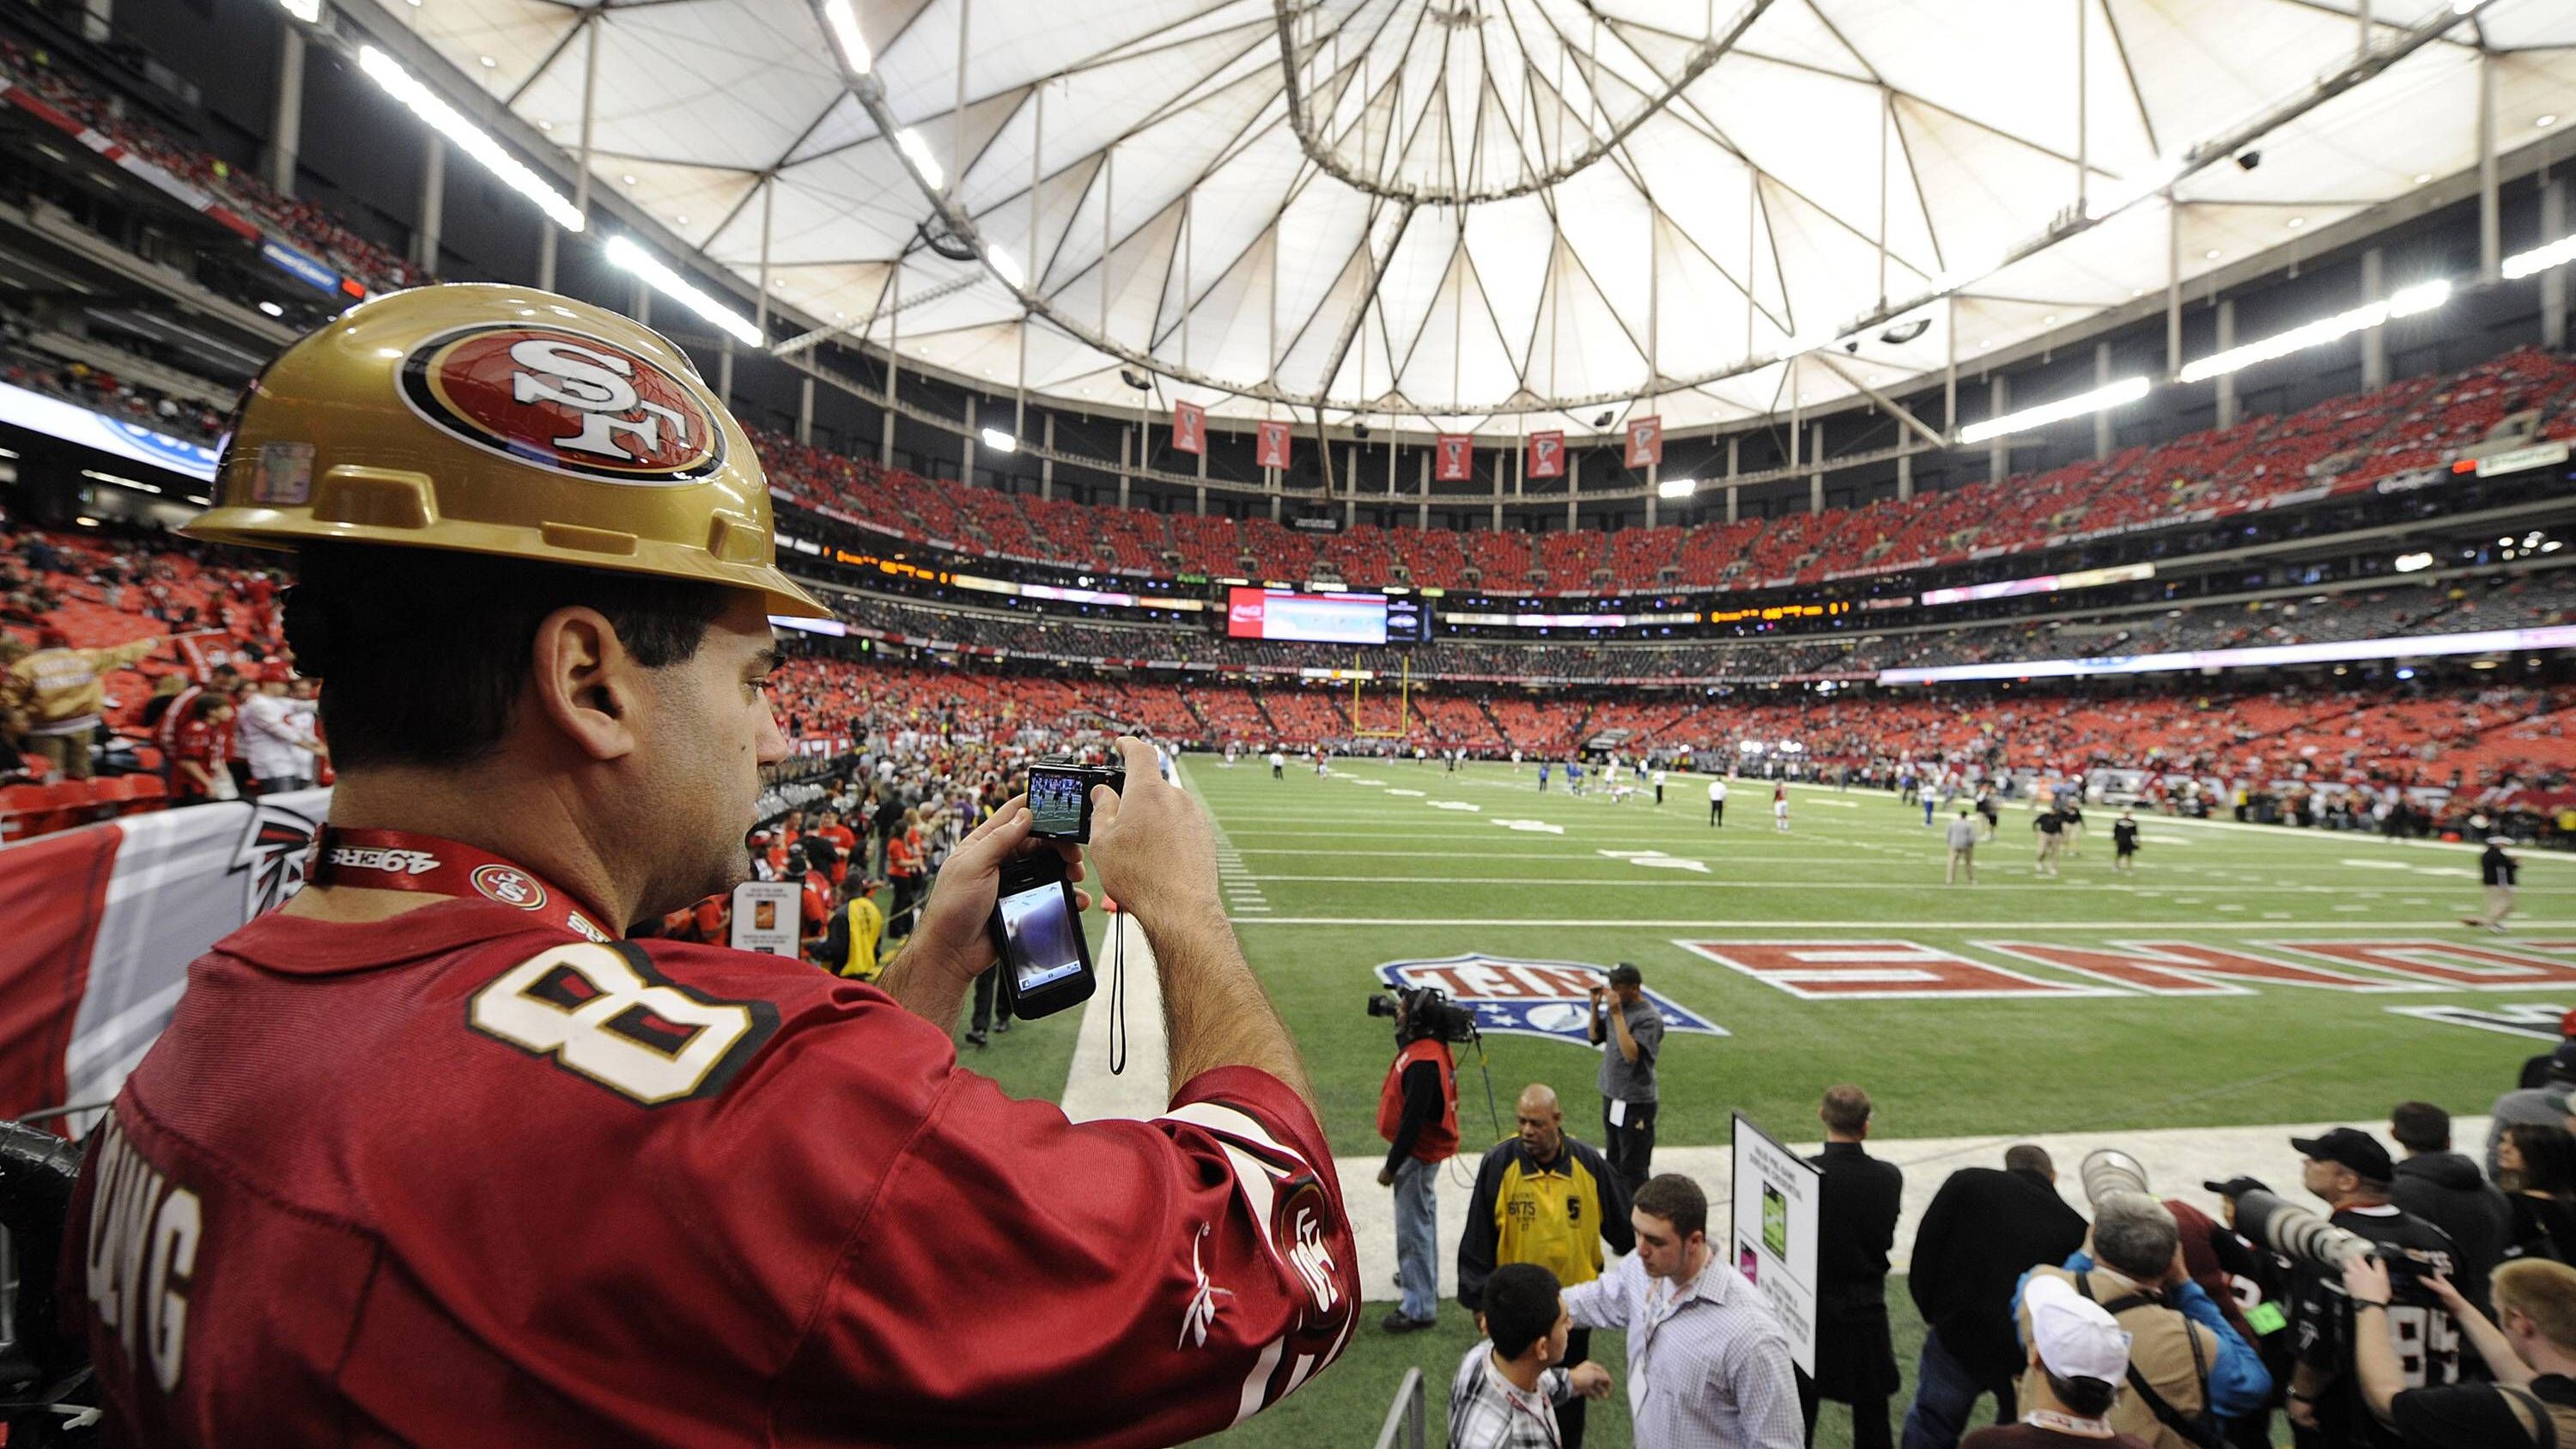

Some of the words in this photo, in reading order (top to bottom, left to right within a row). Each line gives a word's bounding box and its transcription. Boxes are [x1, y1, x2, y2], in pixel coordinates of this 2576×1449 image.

[508, 338, 690, 460] SF
[330, 849, 441, 875] 49ERS
[467, 940, 773, 1108] 8
